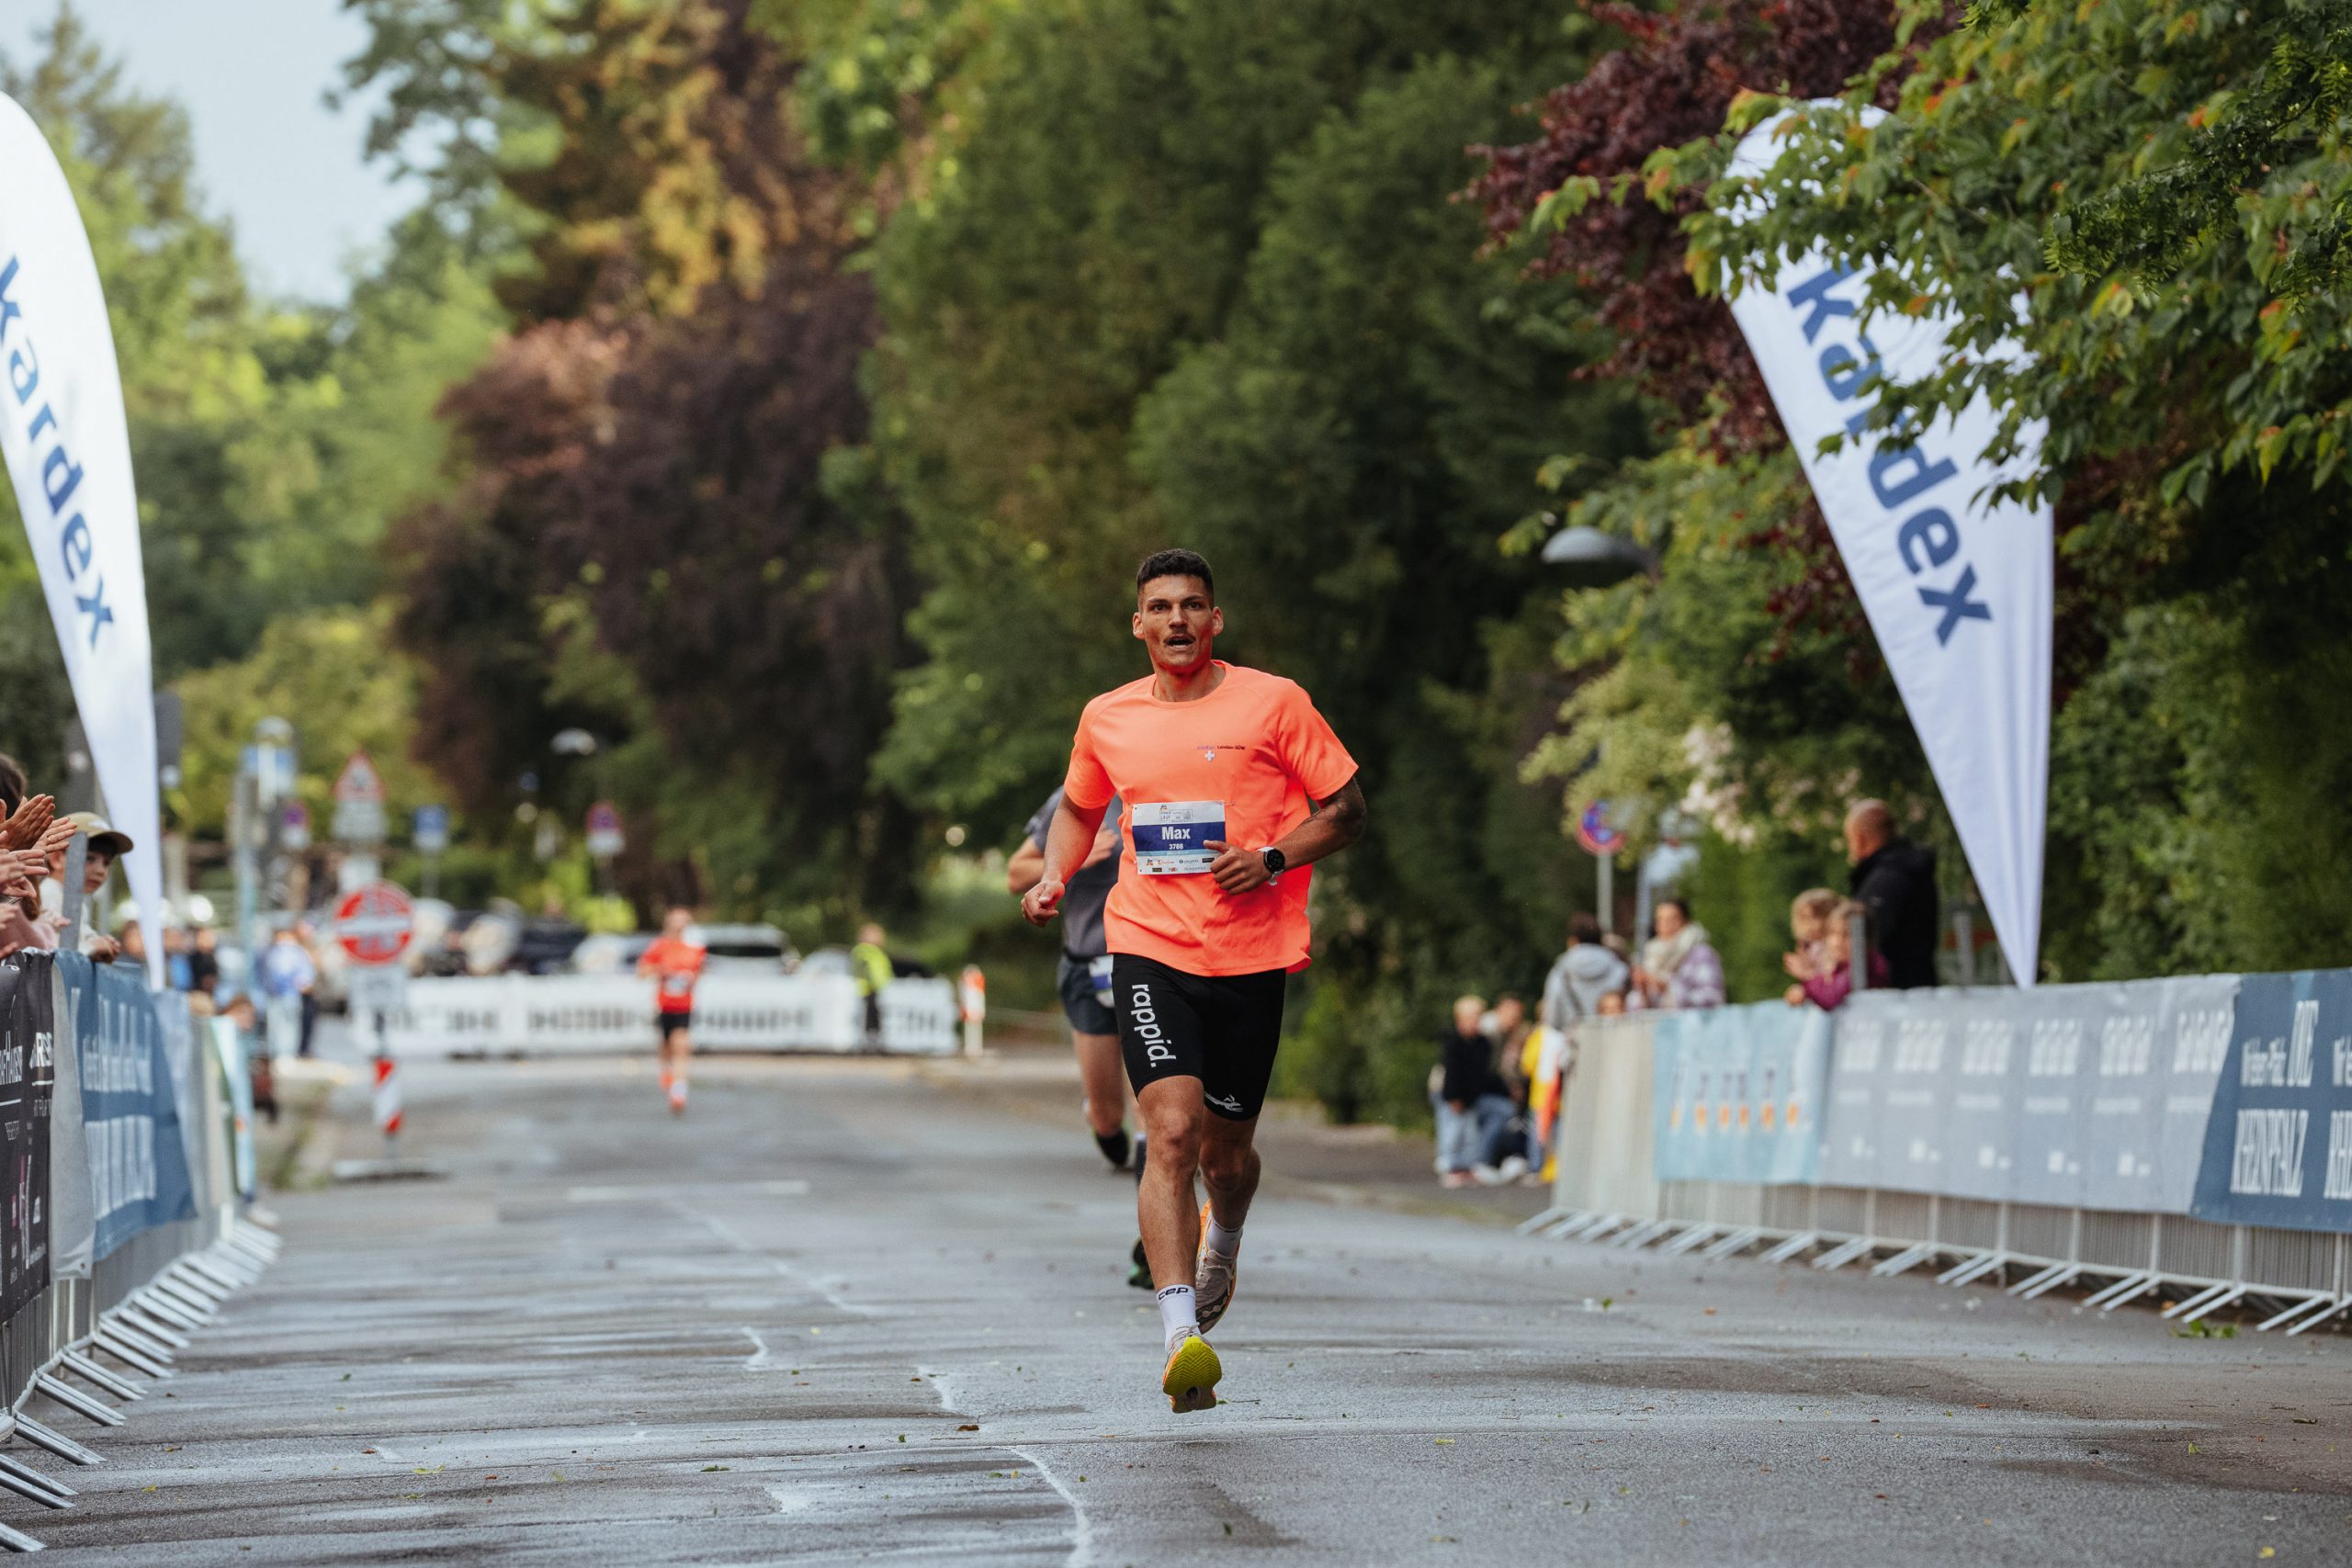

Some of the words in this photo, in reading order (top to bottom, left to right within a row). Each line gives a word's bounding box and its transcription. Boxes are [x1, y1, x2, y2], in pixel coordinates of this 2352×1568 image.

[1161, 826, 1191, 840] Max
[1130, 984, 1177, 1068] rappid.
[1158, 1286, 1189, 1302] cep
